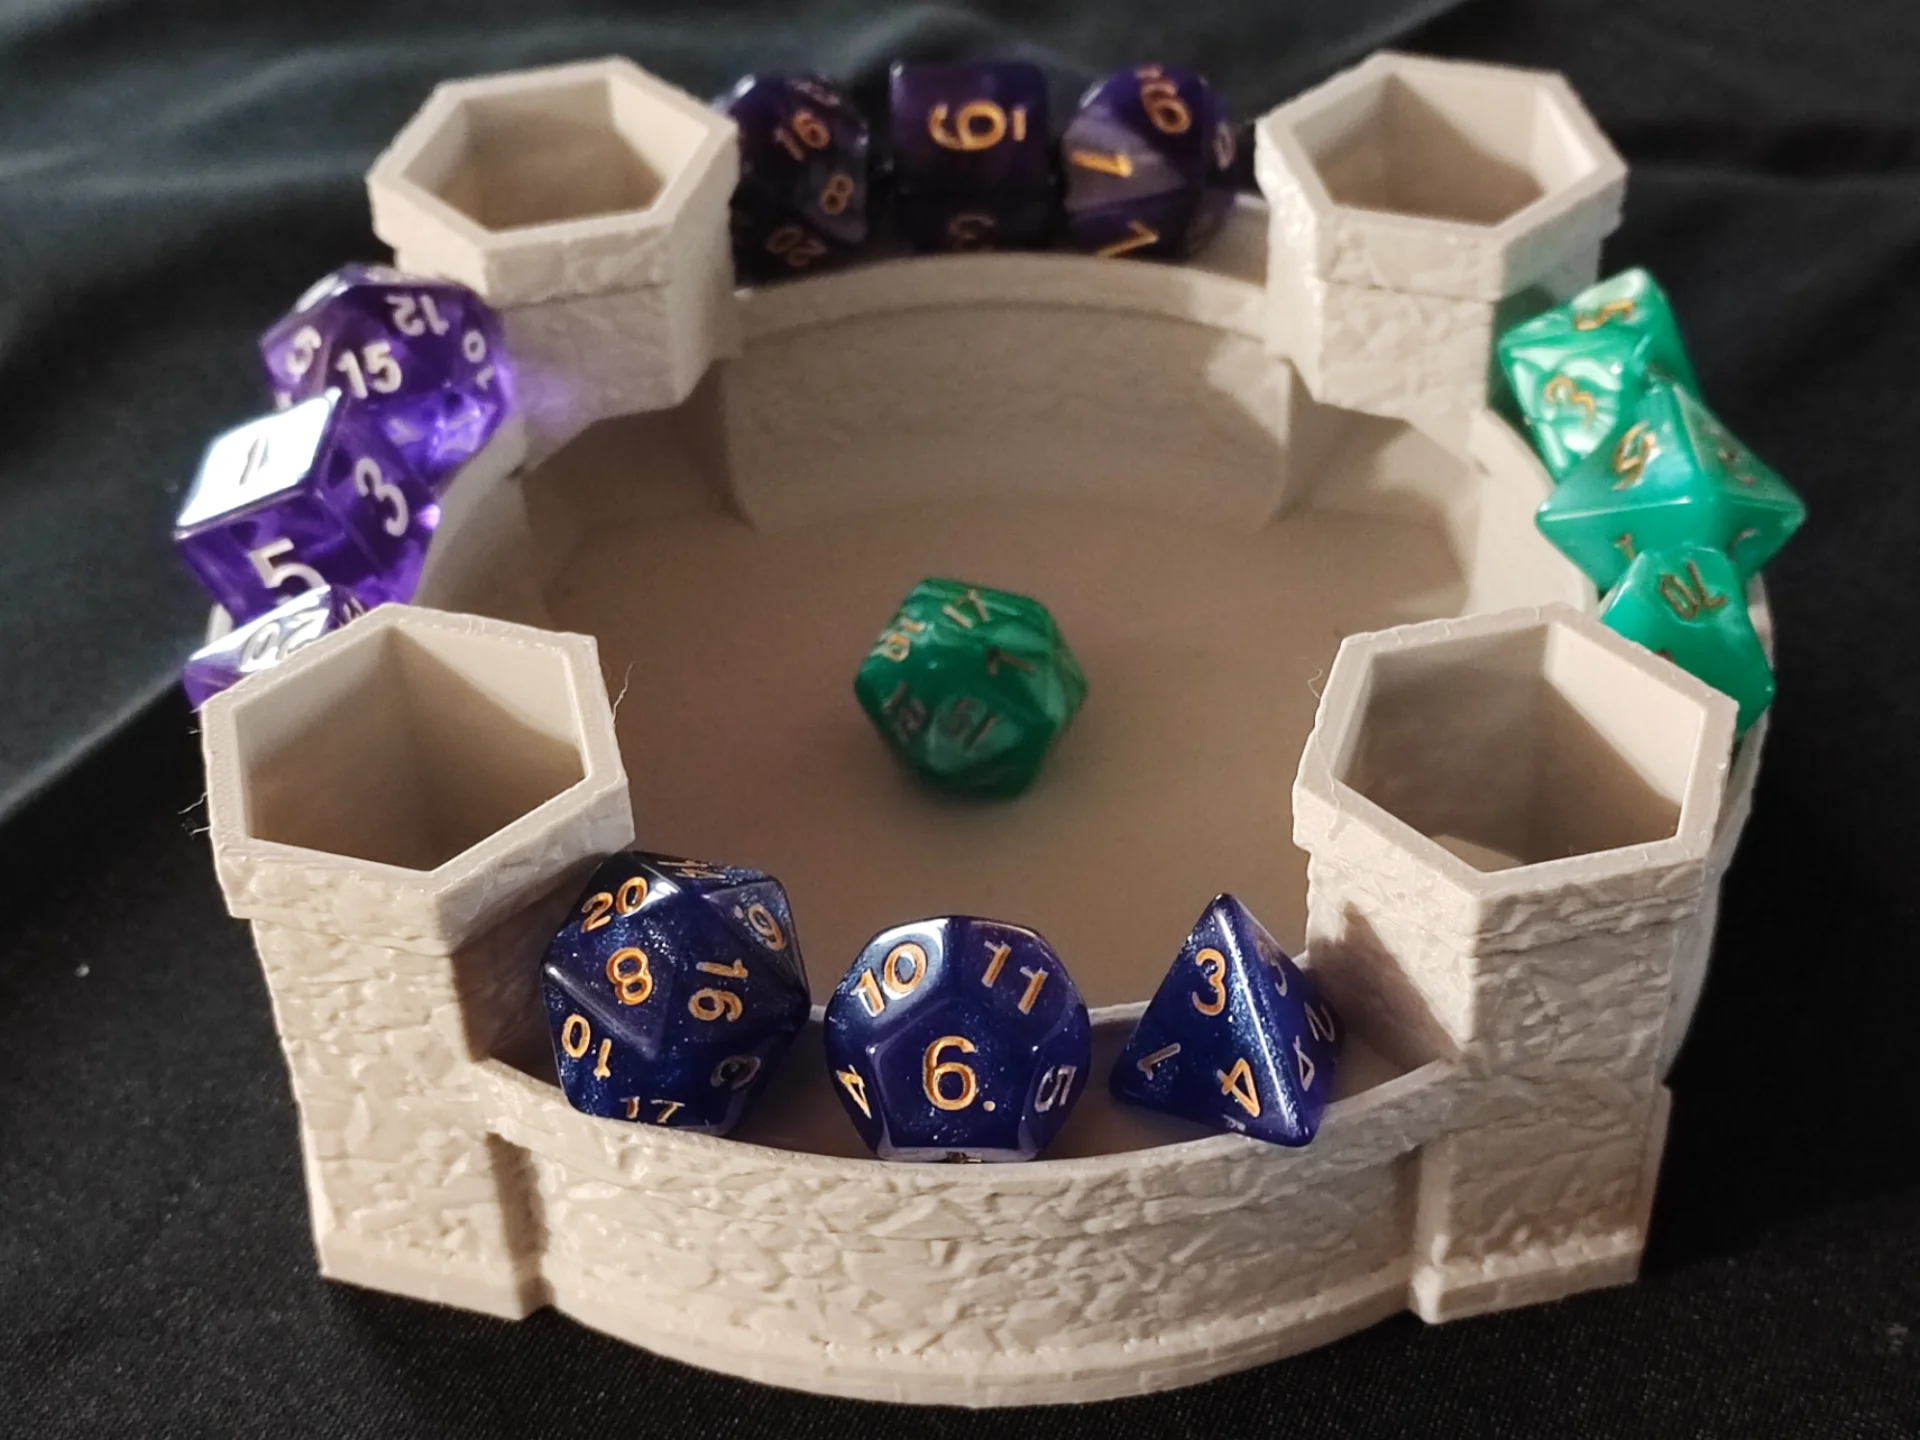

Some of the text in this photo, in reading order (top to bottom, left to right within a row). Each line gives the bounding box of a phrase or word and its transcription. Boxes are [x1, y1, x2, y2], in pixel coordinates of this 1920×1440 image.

[819, 172, 855, 216] 8
[387, 295, 451, 337] 12
[336, 343, 402, 400] 15
[355, 457, 410, 537] 3
[580, 875, 648, 933] 20
[606, 947, 653, 1006] 8
[688, 959, 749, 1022] 16
[850, 942, 928, 1017] 10
[981, 940, 1049, 1015] 11
[1192, 948, 1227, 1016] 3
[1137, 1042, 1181, 1080] 1
[1217, 1057, 1260, 1118] 4
[620, 1096, 685, 1123] 17
[836, 1064, 872, 1119] 4
